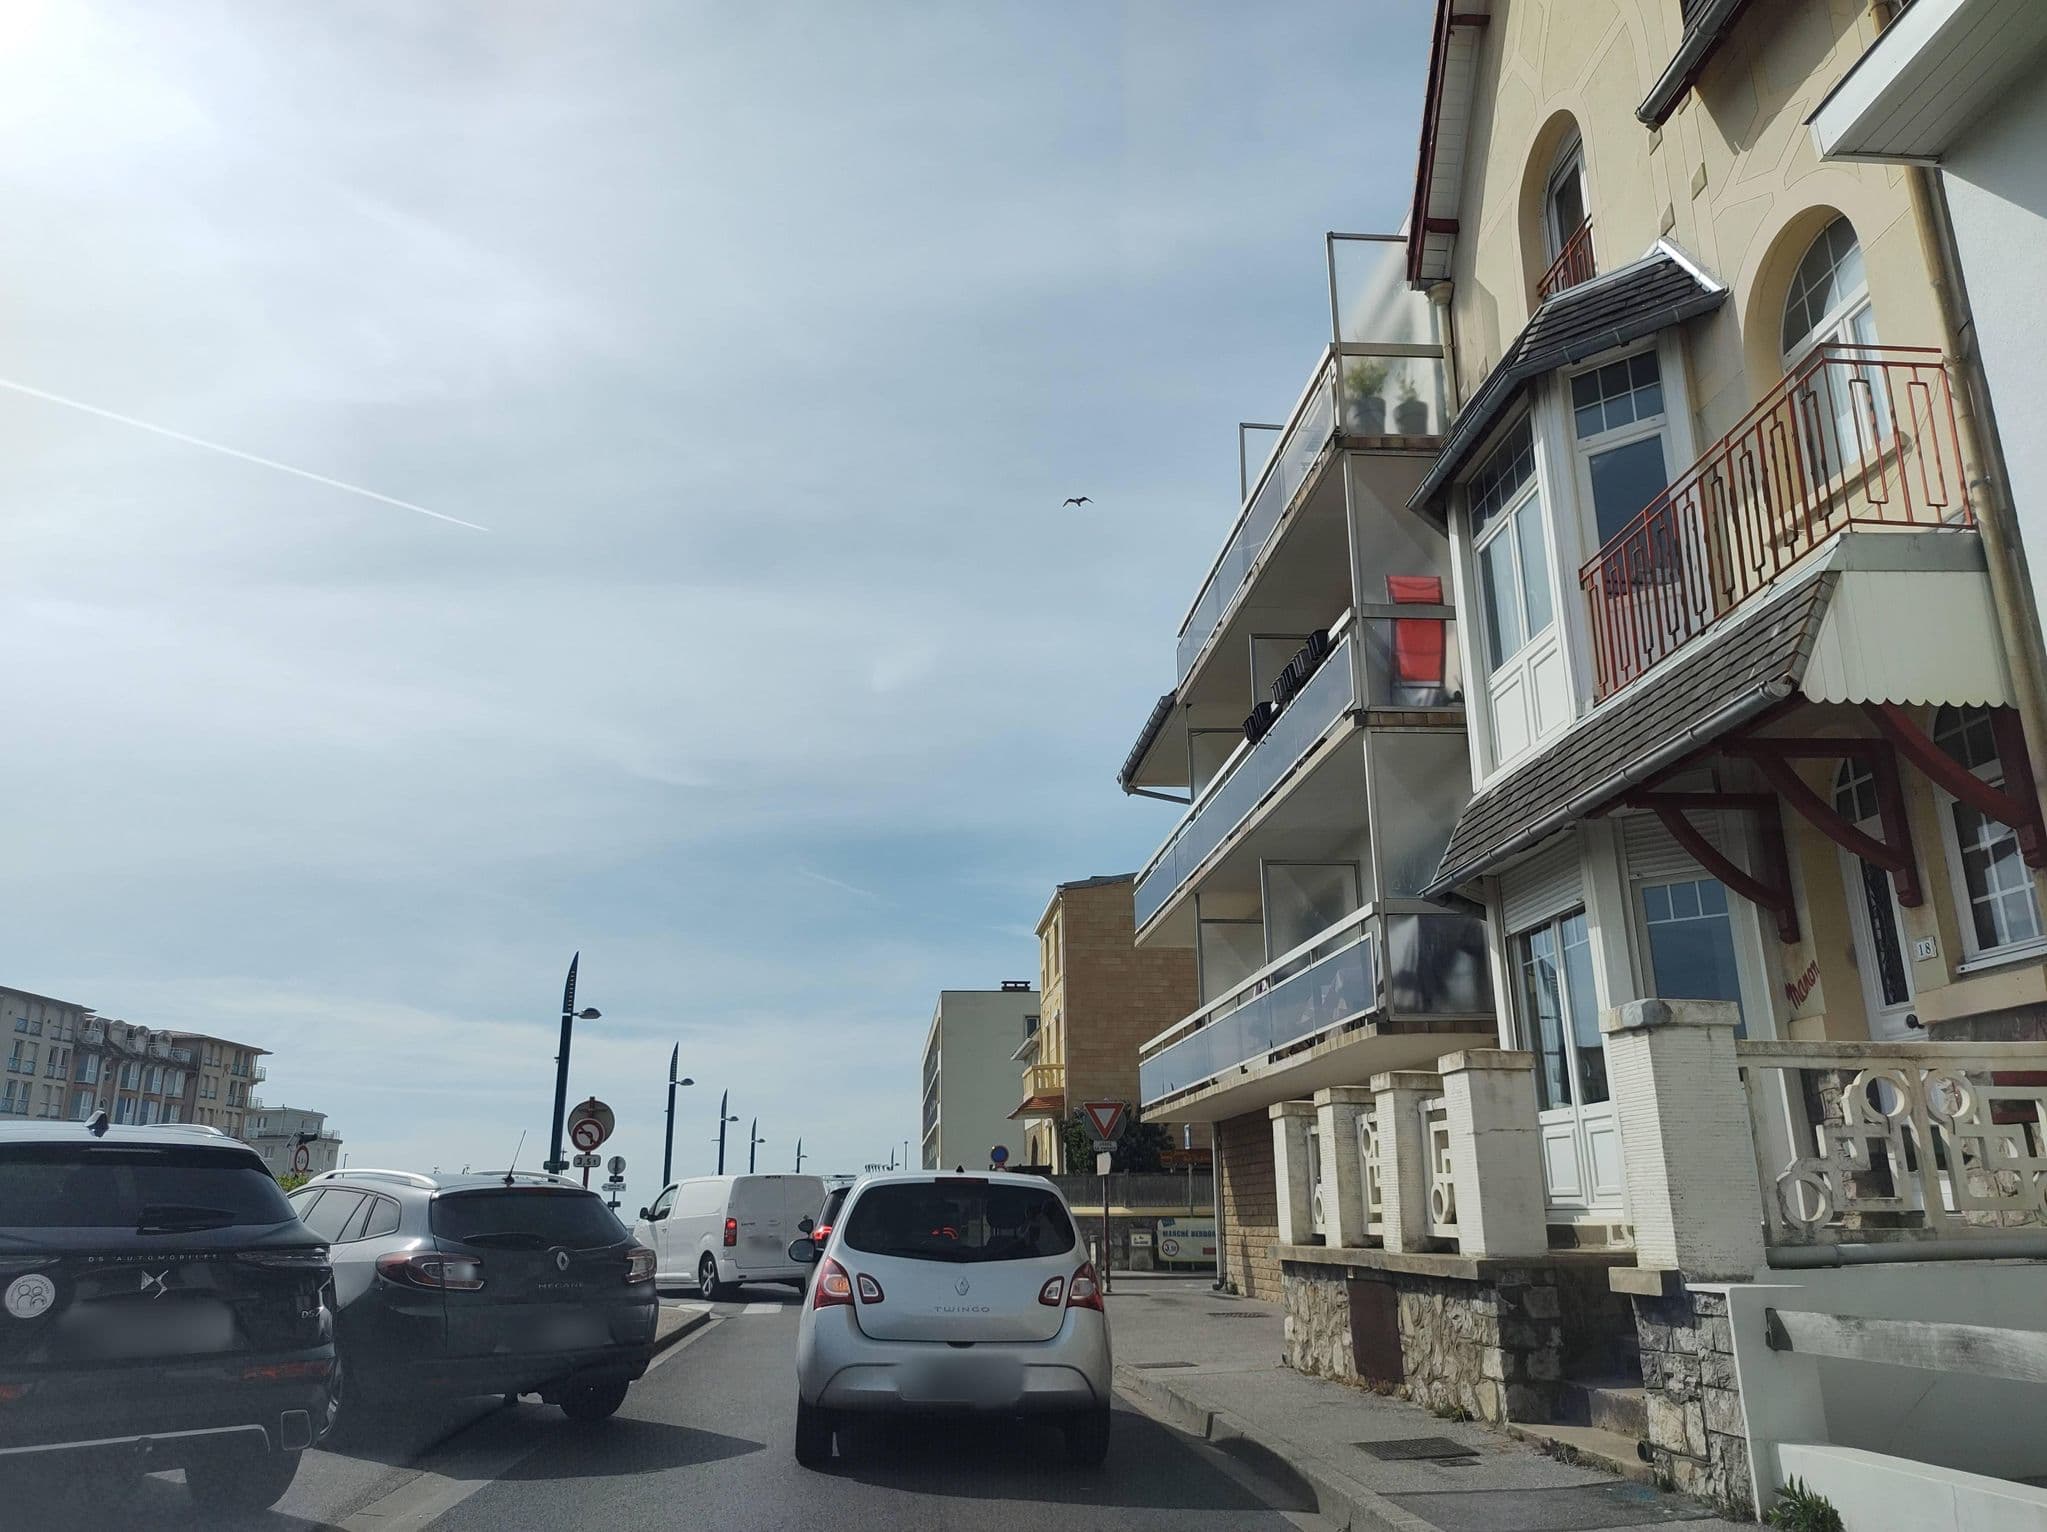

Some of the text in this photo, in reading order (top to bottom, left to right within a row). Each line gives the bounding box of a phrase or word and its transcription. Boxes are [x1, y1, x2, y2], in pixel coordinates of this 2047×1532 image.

[1918, 942, 1932, 956] 18
[1784, 959, 1821, 1010] Manon
[1162, 1228, 1189, 1237] MARCHÉ
[115, 1254, 218, 1262] AUTOMOBILES
